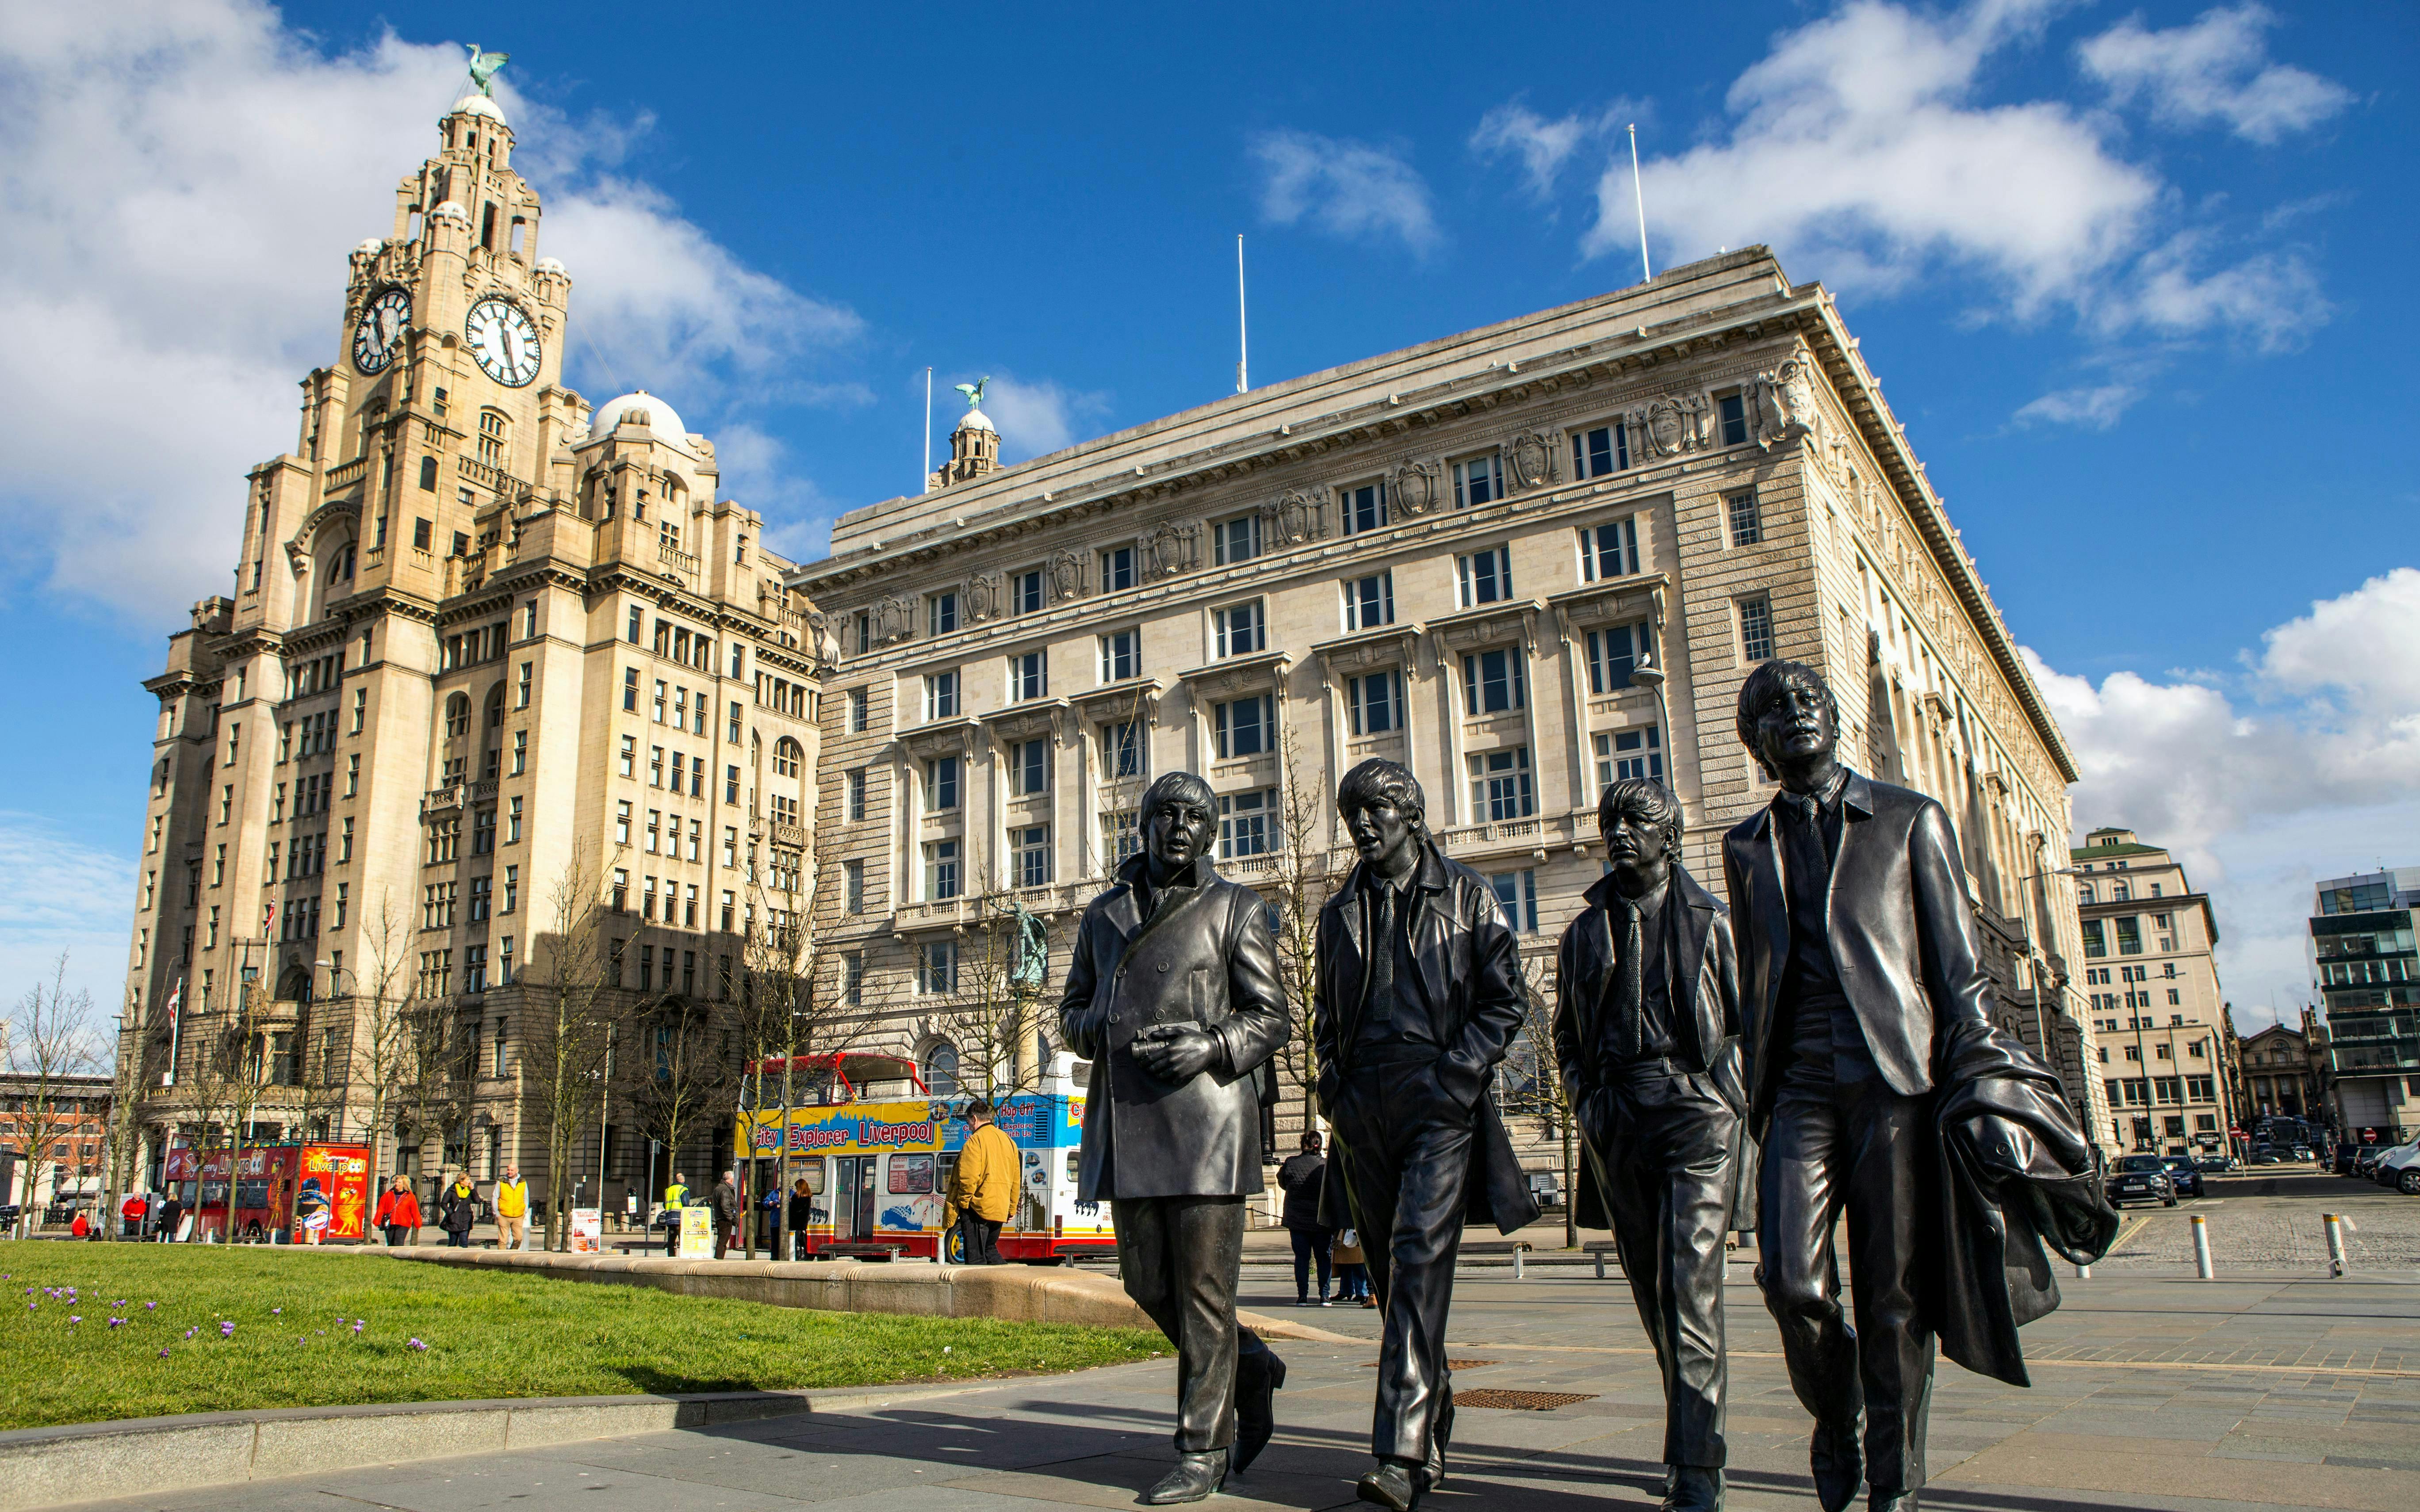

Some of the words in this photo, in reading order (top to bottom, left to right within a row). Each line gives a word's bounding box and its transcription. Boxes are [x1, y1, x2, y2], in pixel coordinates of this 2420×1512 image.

[1001, 1104, 1017, 1120] Hop
[1019, 1102, 1035, 1116] Off
[790, 1125, 849, 1149] Explorer
[859, 1120, 934, 1145] Liverpool
[1003, 1122, 1034, 1130] Explore
[309, 1158, 366, 1176] Livepool
